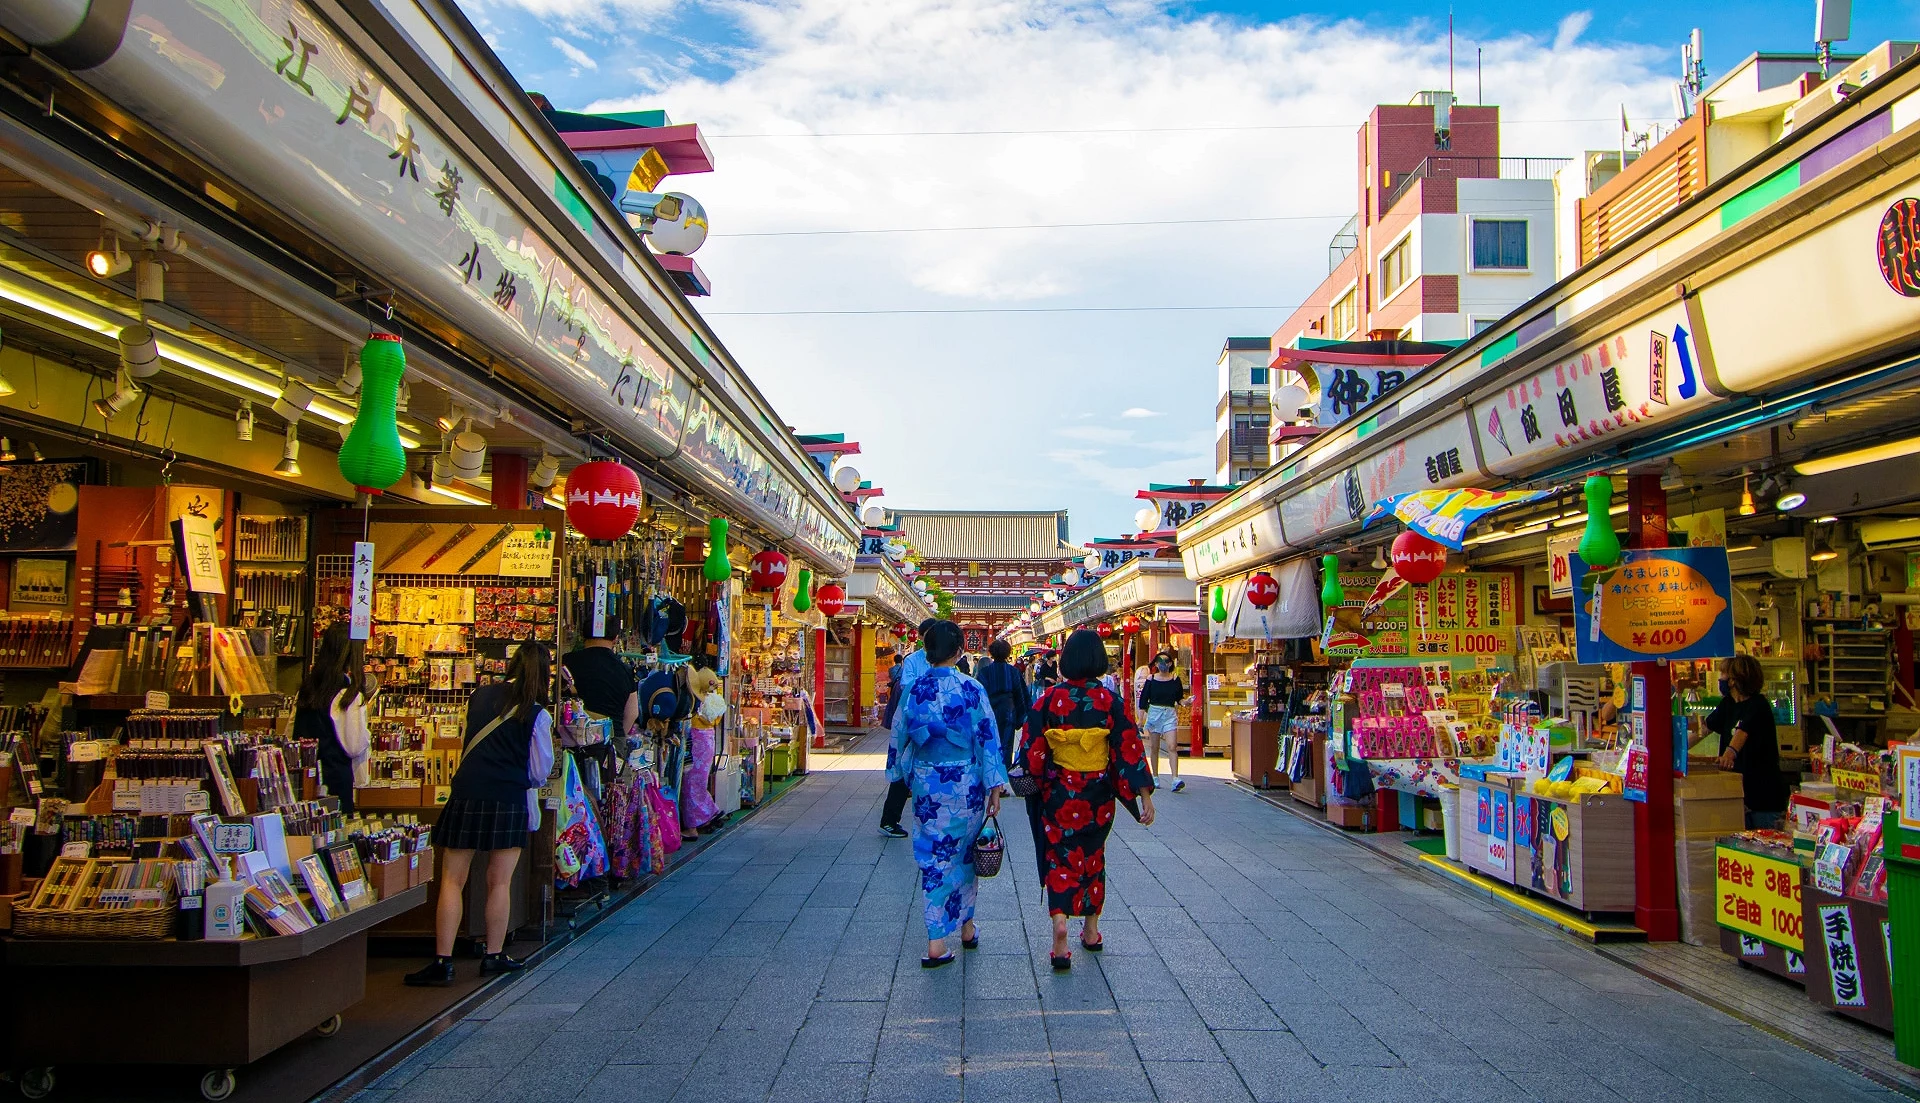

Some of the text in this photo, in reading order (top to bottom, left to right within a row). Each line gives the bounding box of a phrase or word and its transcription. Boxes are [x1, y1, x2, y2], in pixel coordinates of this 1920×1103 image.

[277, 21, 516, 310] 江戸木箸 小物
[1521, 367, 1627, 444] 飯田屋
[1395, 498, 1466, 542] Lemonade
[1623, 566, 1680, 579] なましぼり
[1465, 578, 1478, 628] おこげせん
[1623, 595, 1686, 610] レモネード
[1650, 609, 1684, 617] squeezed
[1438, 618, 1457, 628] セット
[1632, 628, 1688, 647] ¥400
[1718, 855, 1755, 888] 組合せ
[1723, 894, 1762, 927] ご自由
[1824, 911, 1857, 1000] 手焼き
